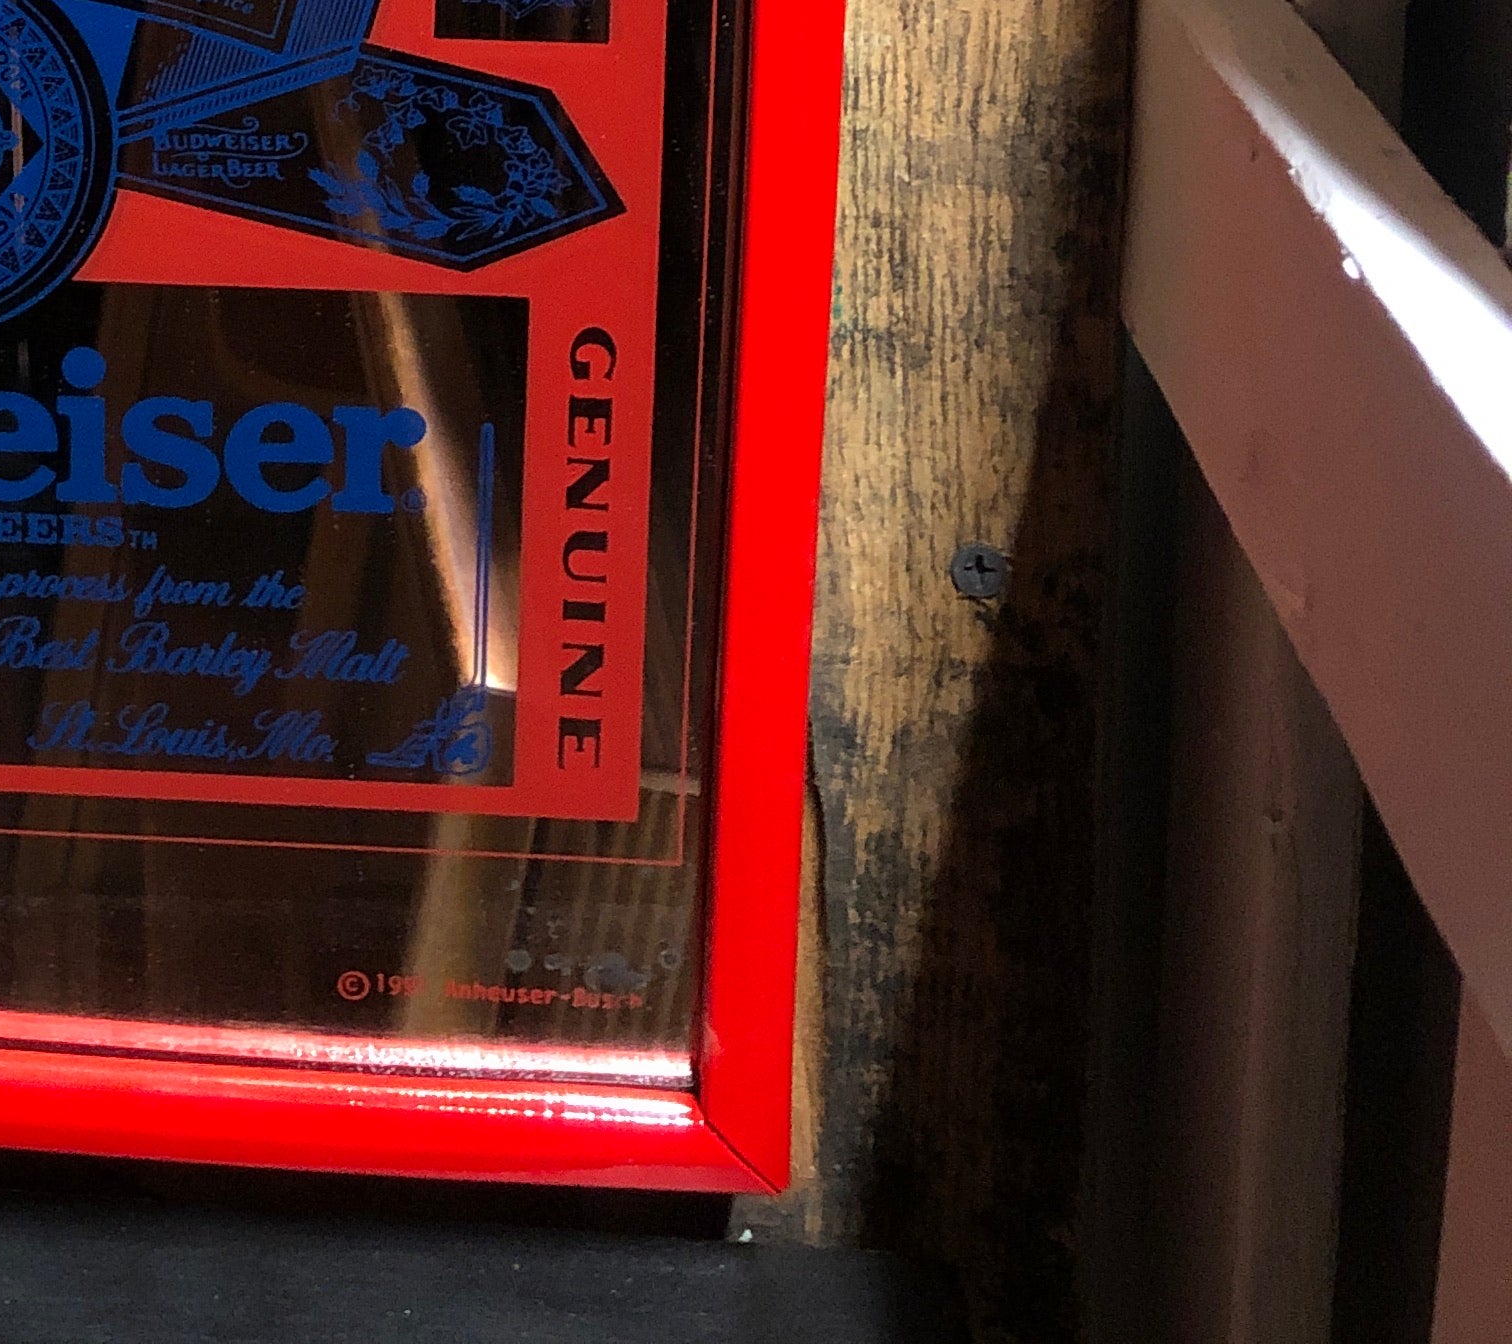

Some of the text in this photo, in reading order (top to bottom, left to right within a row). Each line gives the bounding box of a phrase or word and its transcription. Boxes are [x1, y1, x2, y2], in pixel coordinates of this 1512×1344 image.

[153, 125, 293, 152] BUDWEISER
[152, 152, 283, 180] LAGER BEER
[557, 326, 618, 770] GENUINE
[134, 563, 234, 617] from
[243, 569, 307, 610] the
[107, 620, 273, 697] Barley
[275, 628, 412, 686] Malt
